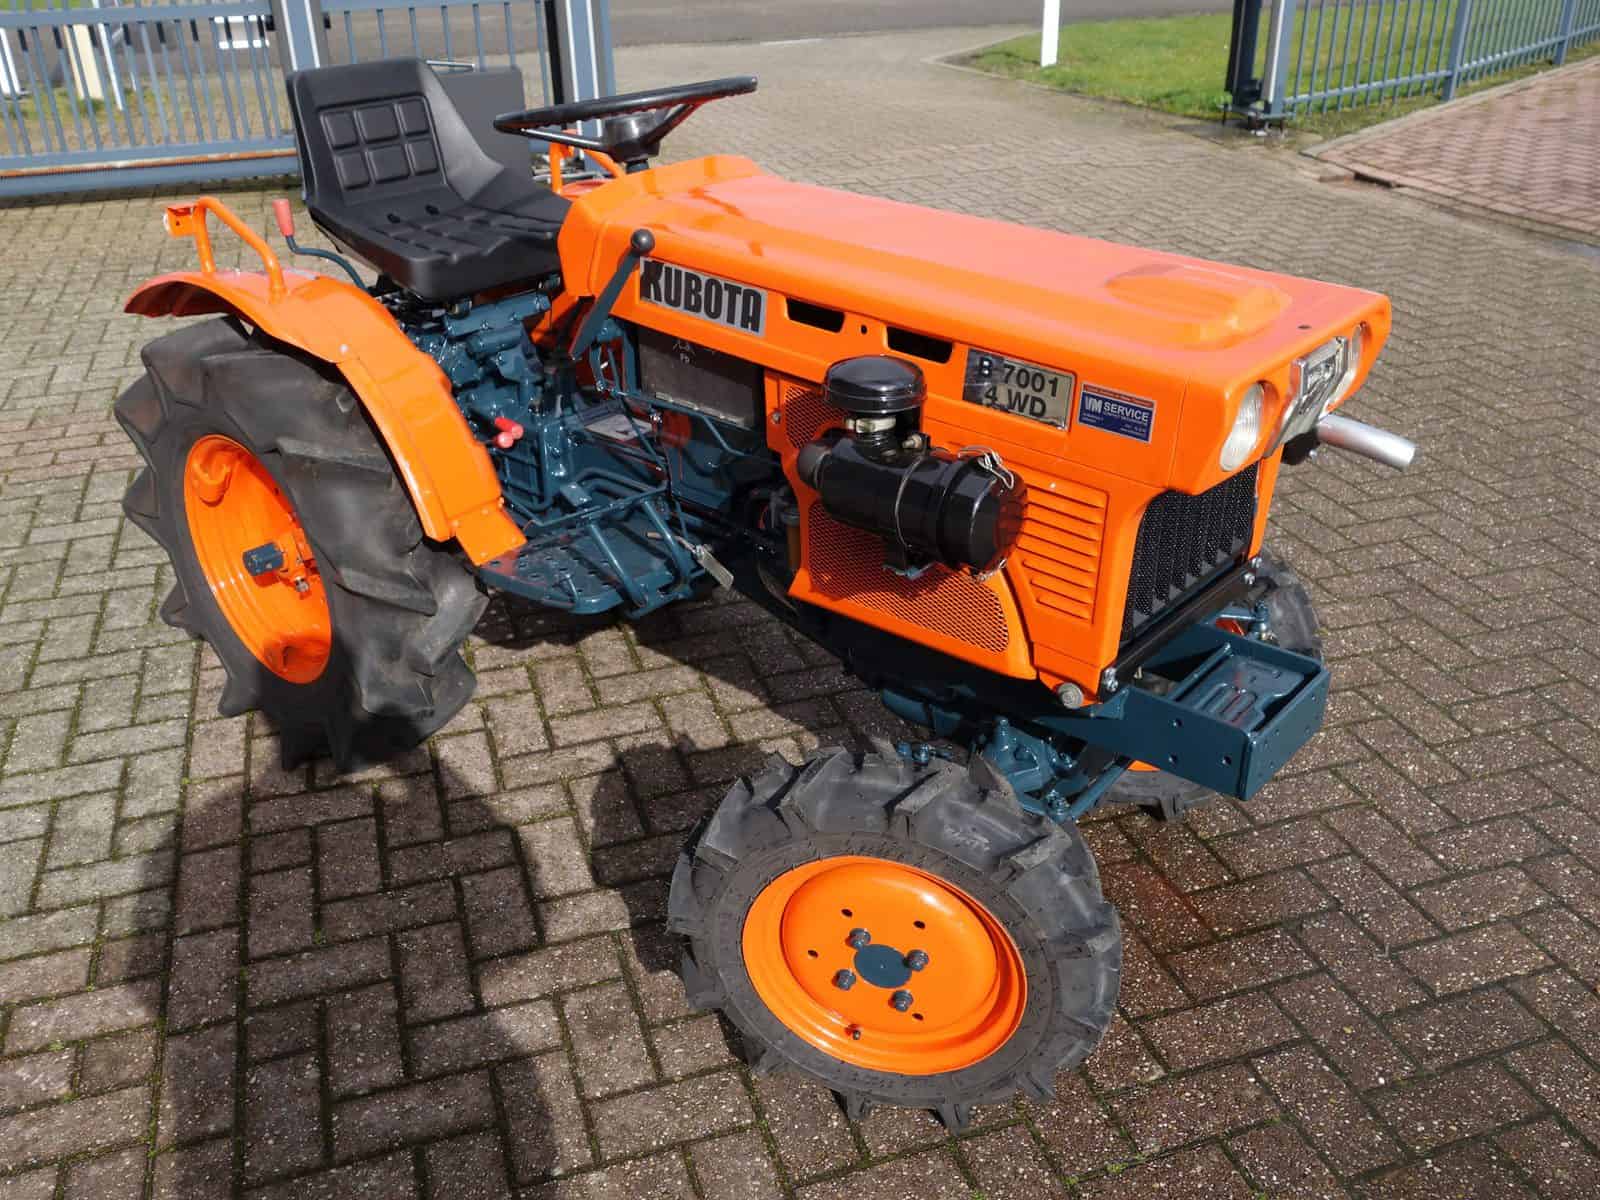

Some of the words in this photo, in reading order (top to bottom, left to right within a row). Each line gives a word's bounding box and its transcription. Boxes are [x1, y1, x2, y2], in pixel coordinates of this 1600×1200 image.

[640, 259, 762, 333] KUBOTA
[979, 356, 993, 378] B
[1004, 364, 1059, 397] 7001
[985, 385, 998, 407] 4
[1008, 389, 1046, 417] WD
[1103, 401, 1150, 422] SERVICE
